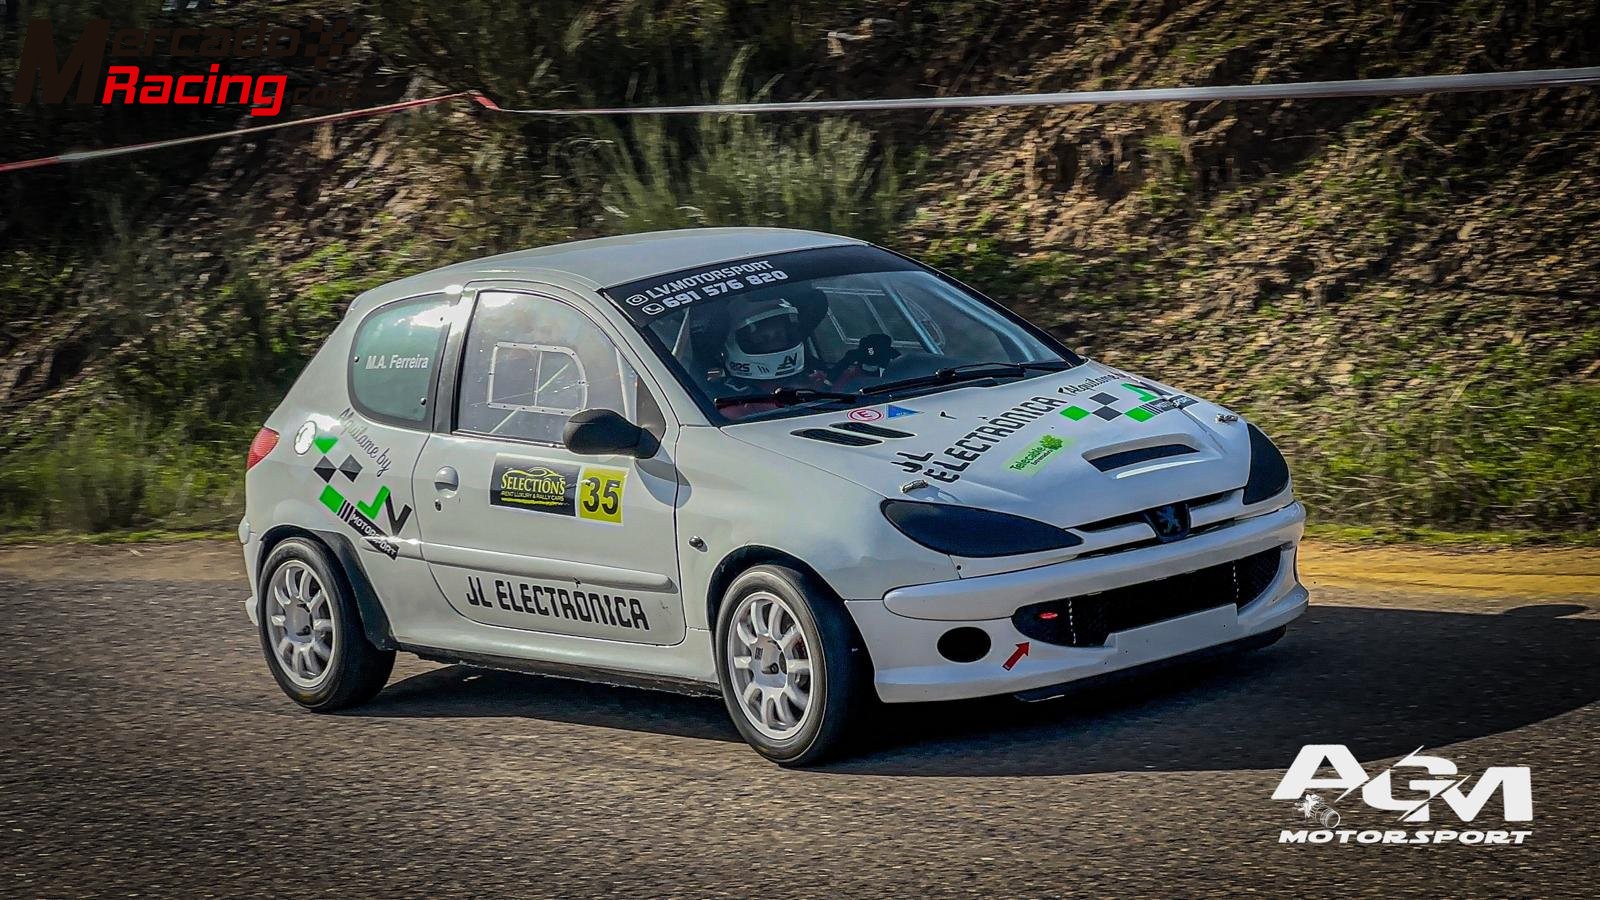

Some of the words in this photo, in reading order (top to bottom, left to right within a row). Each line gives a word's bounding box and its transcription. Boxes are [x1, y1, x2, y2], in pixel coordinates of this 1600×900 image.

[645, 260, 775, 299] LV.MOTORSPORT
[662, 290, 702, 309] 691
[701, 279, 744, 298] 576
[745, 270, 789, 286] 820
[365, 355, 387, 370] M.A.
[389, 354, 429, 370] Ferreira
[376, 447, 392, 478] by
[891, 452, 935, 474] JL
[500, 473, 566, 496] SELECTIONS
[583, 477, 622, 515] 35
[351, 511, 398, 555] MOTORSPORT
[466, 576, 493, 607] JL
